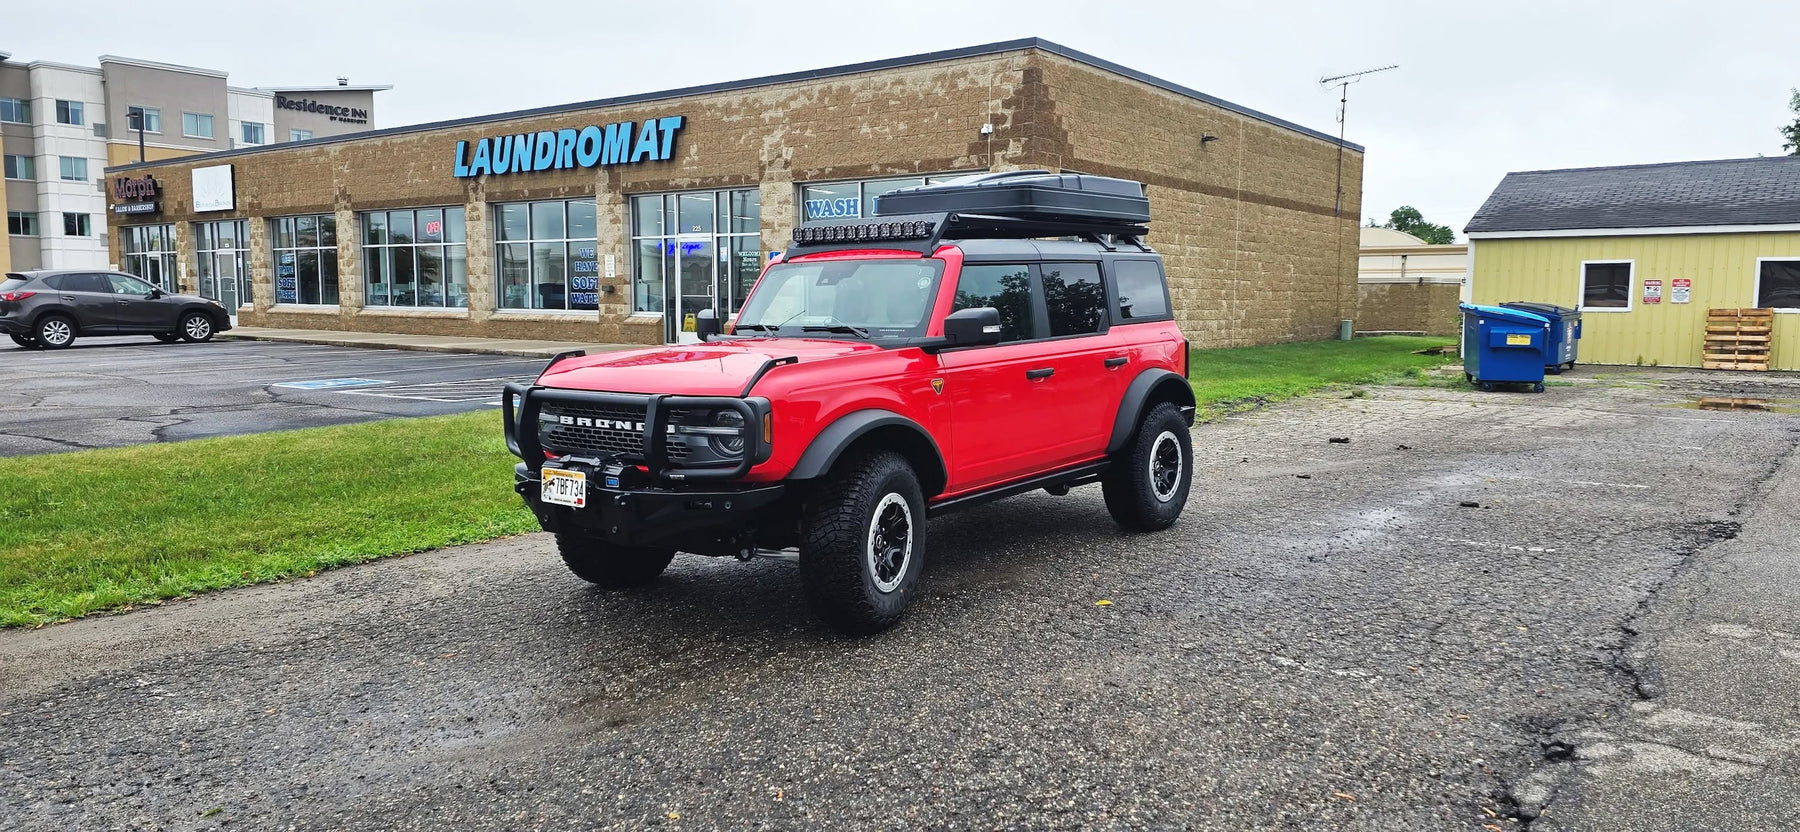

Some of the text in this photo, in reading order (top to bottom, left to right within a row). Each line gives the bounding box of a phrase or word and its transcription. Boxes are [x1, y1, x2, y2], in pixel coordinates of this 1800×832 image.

[277, 95, 368, 119] Residence INN
[453, 115, 685, 178] LAUNDROMAT
[113, 174, 155, 201] Morph
[805, 197, 859, 218] WASH
[579, 248, 594, 258] WE
[575, 261, 598, 271] HAVE
[571, 292, 598, 304] WATE
[555, 478, 584, 497] 7BF734
